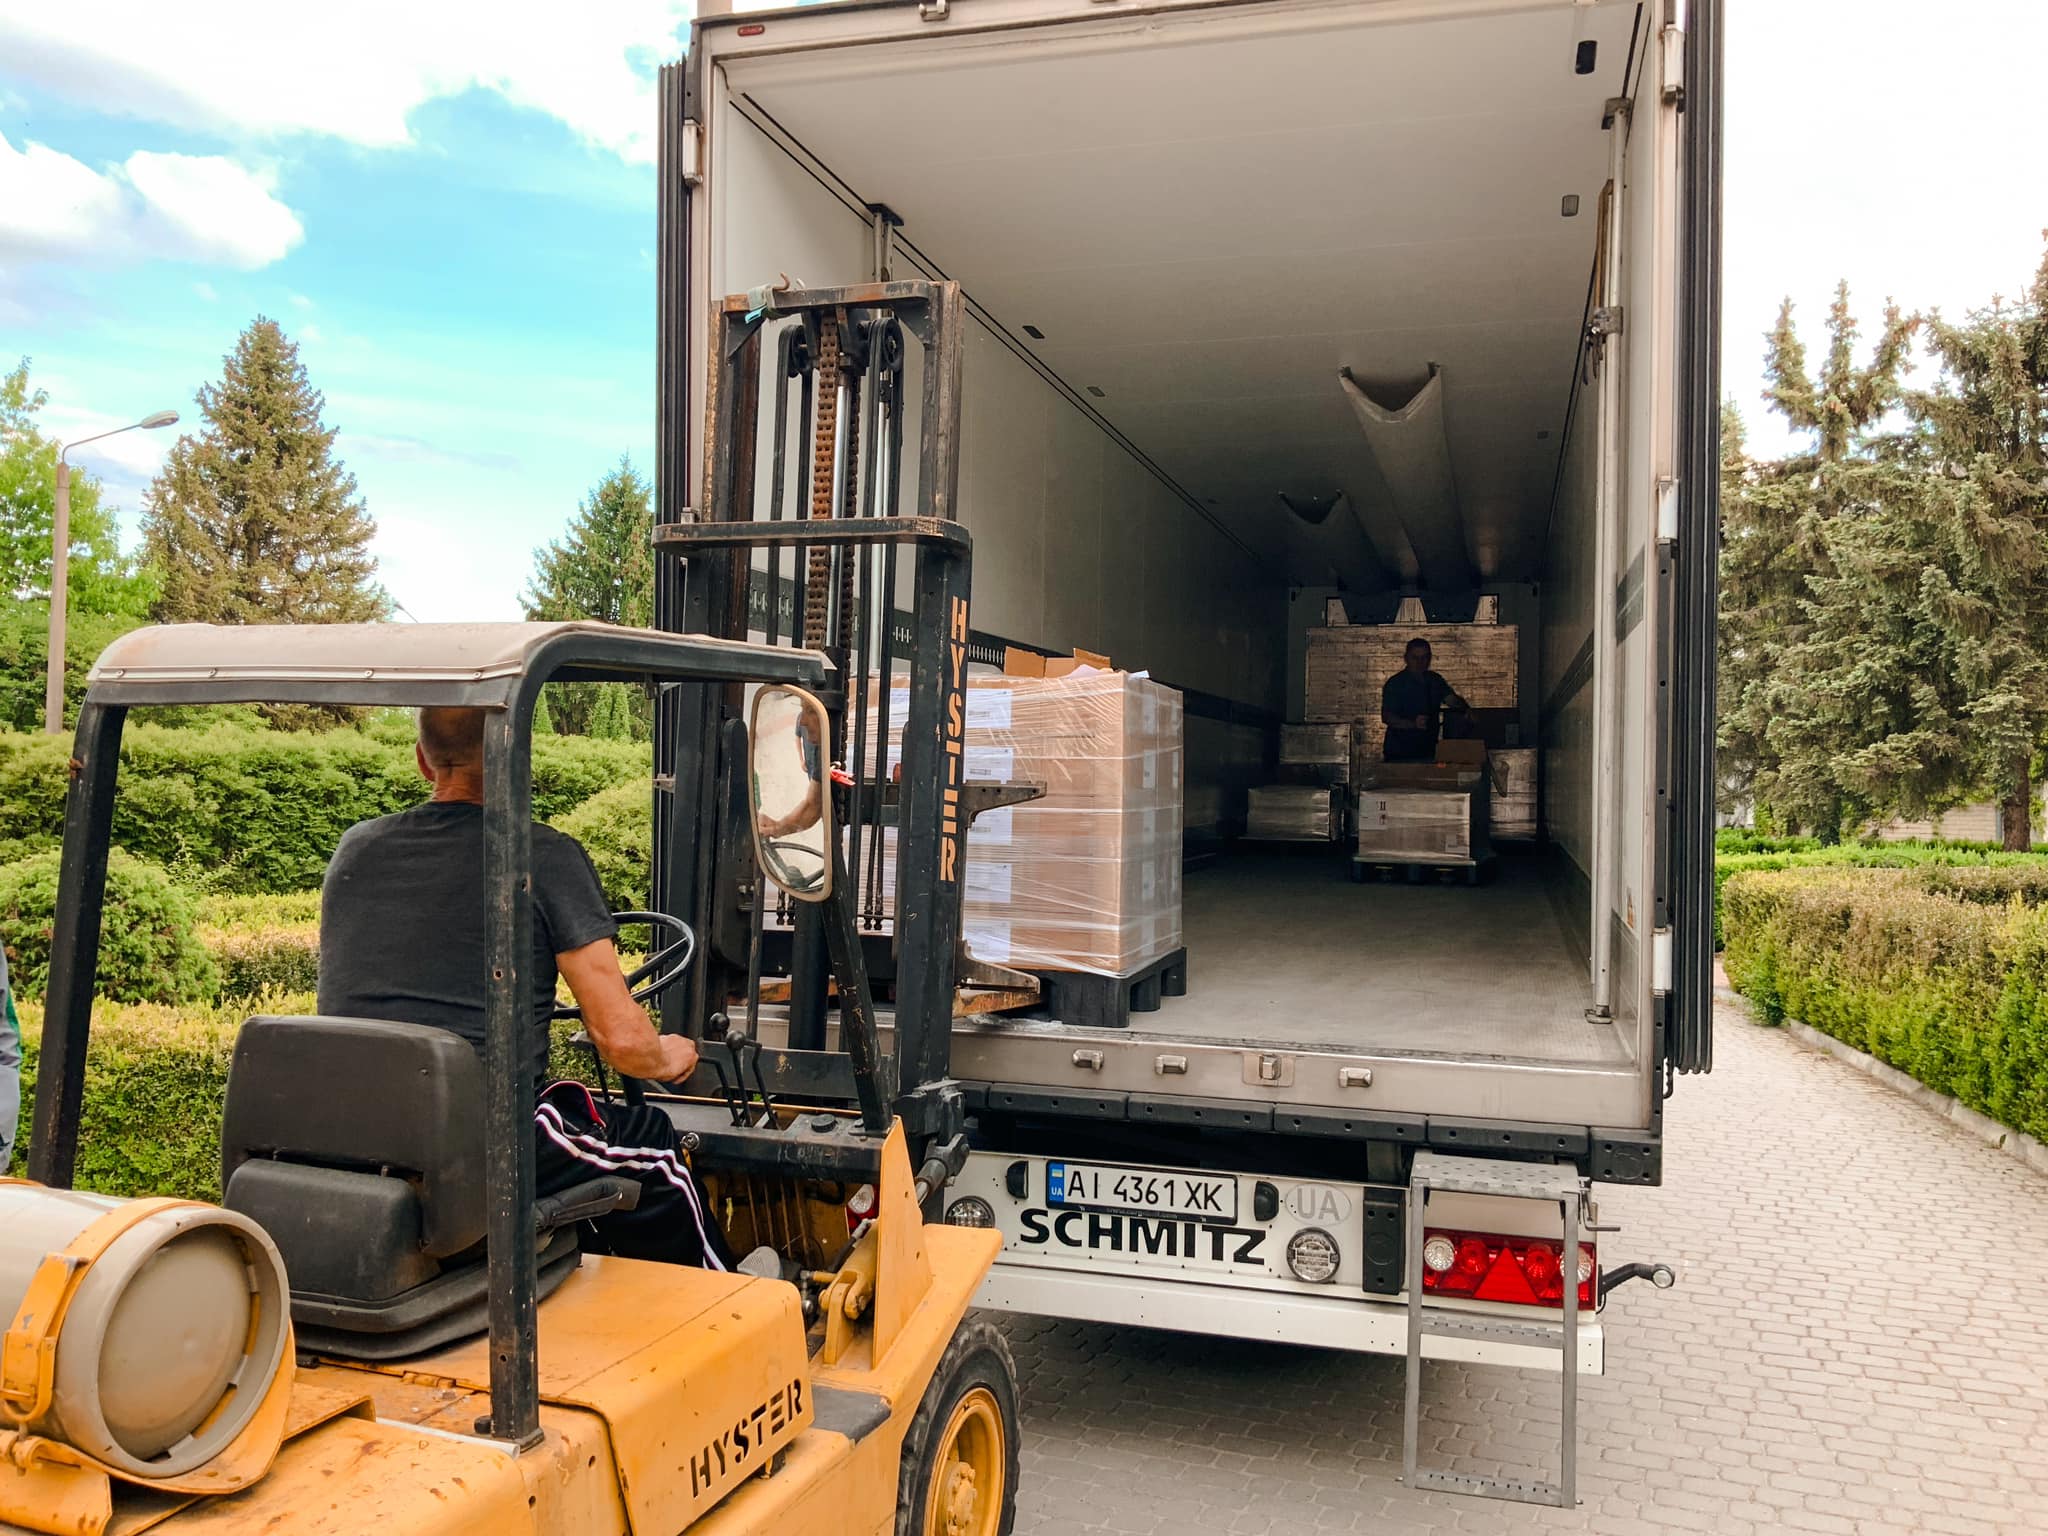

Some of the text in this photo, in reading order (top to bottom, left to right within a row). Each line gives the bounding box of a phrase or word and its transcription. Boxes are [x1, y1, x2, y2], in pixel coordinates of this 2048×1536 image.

[940, 596, 967, 882] HYSTER
[1051, 1187, 1063, 1196] UA
[1067, 1171, 1223, 1212] AI 4361 XK
[1297, 1187, 1340, 1221] UA
[1020, 1208, 1267, 1266] SCHMITZ
[690, 1378, 803, 1498] HYSTER
